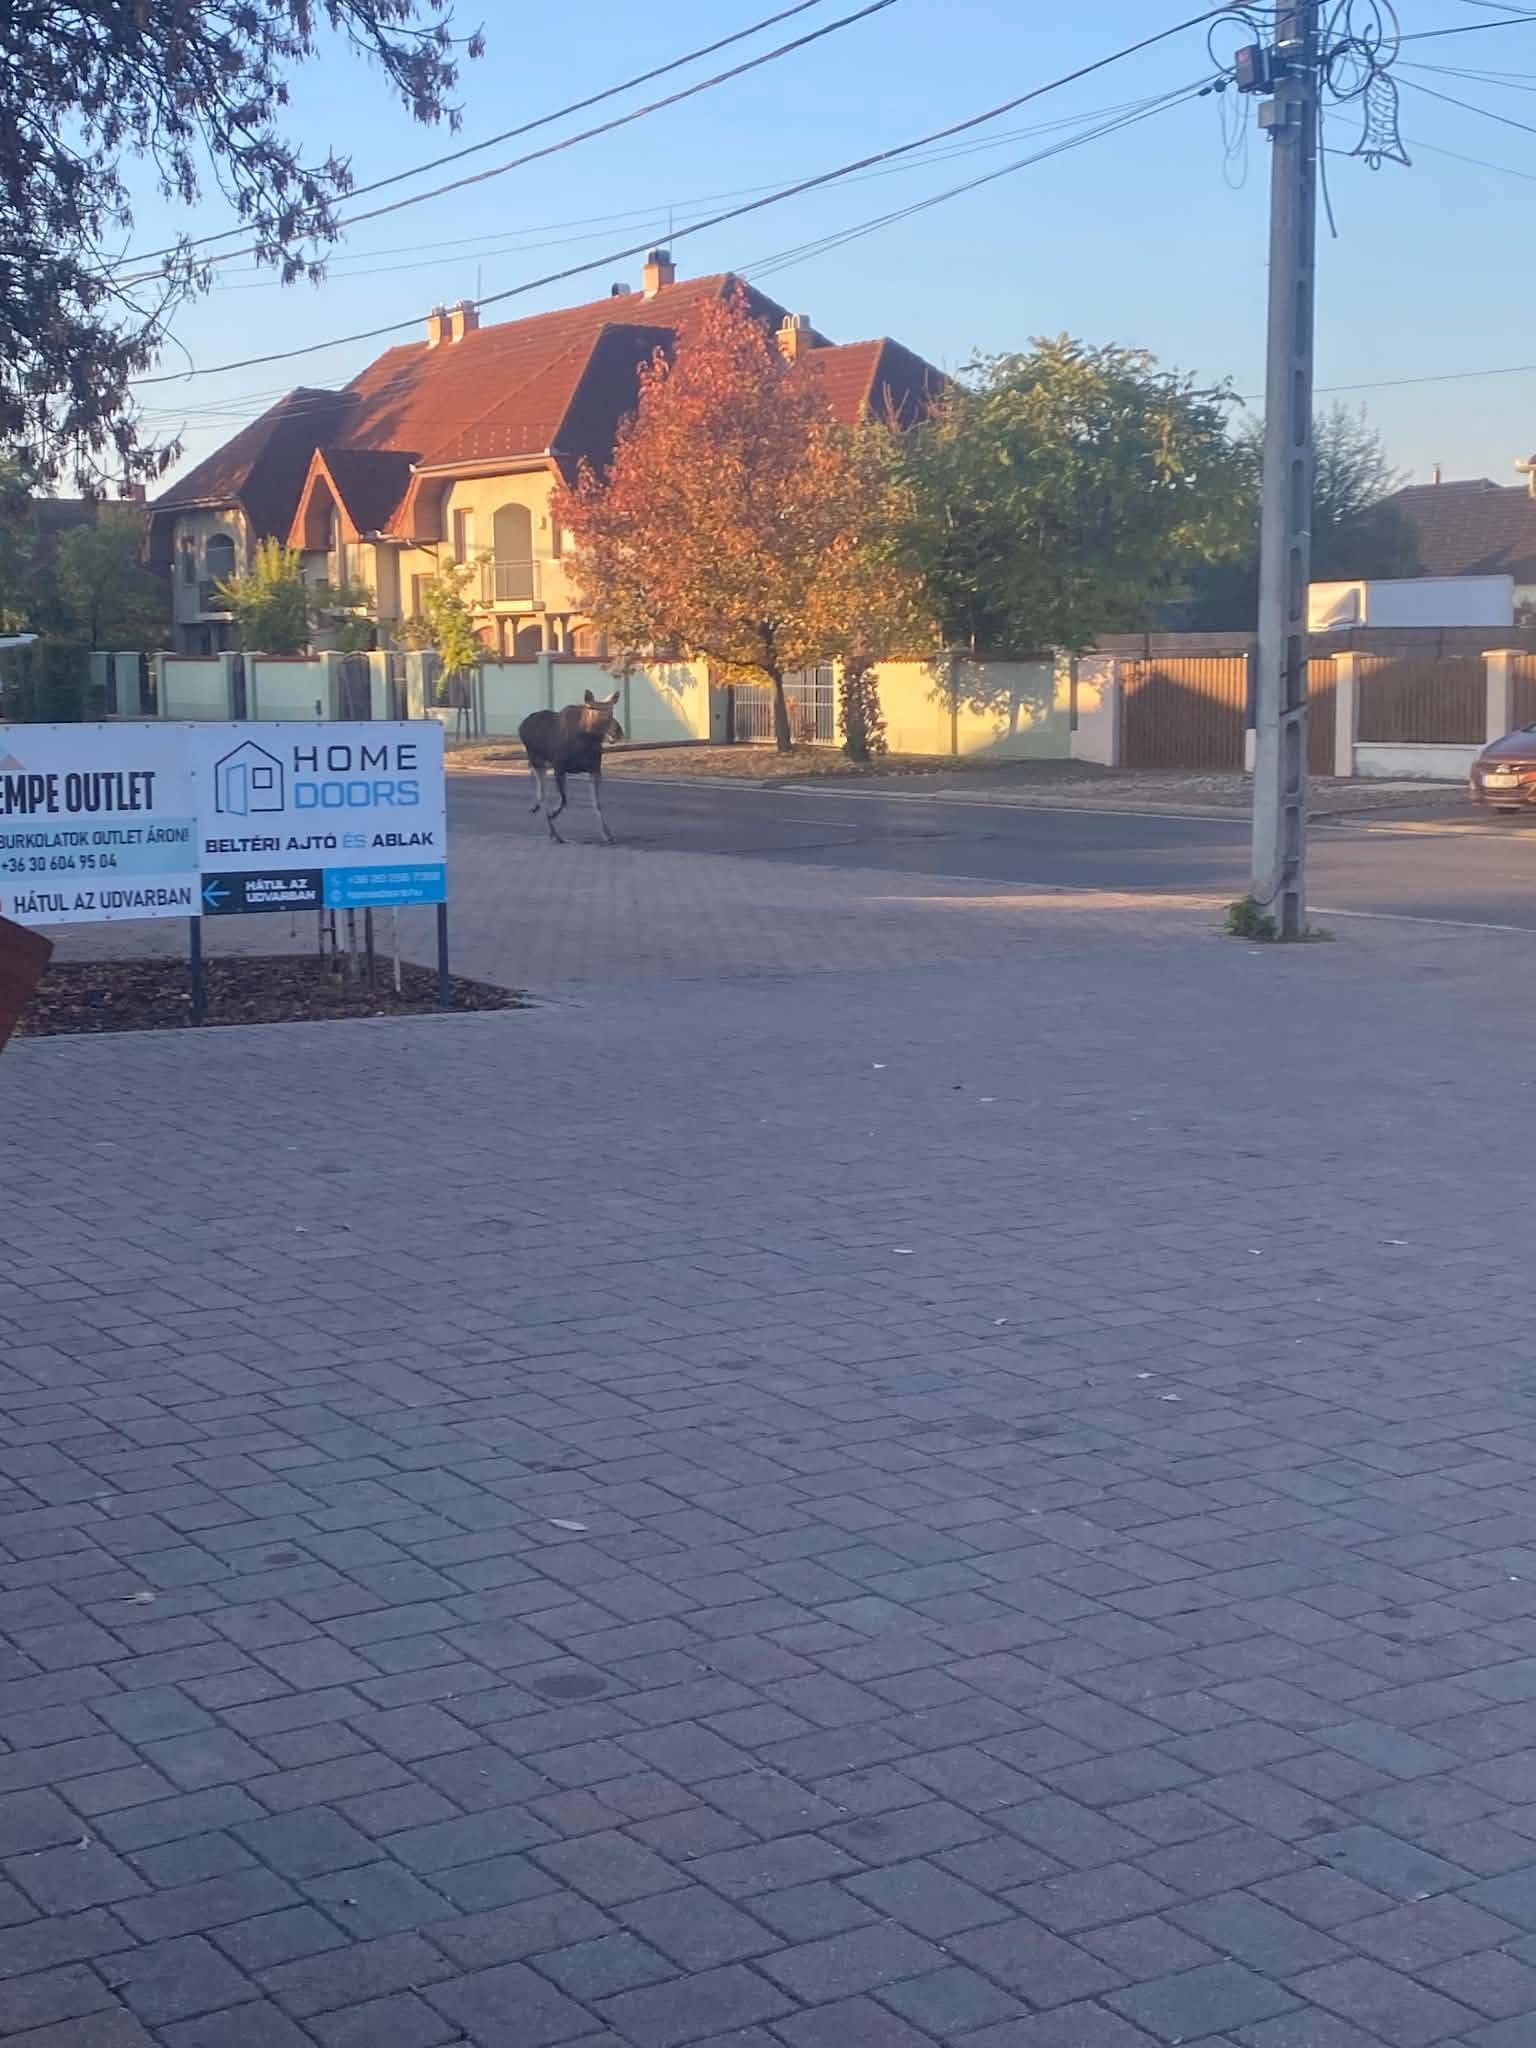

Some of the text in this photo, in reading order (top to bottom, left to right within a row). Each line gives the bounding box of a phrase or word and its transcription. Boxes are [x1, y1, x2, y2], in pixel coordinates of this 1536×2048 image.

[293, 744, 417, 772] HOME
[0, 771, 156, 815] MPE OUTLET
[294, 780, 420, 809] DOORS
[92, 829, 143, 846] OUTLET
[205, 831, 433, 853] BELTÉRI AJTÓ ÉS ABLAK
[2, 853, 118, 873] +36 30 604 95 04
[245, 878, 308, 891] HÁTUL AZ
[14, 887, 192, 914] HÁTUL AZ UDVARBAN
